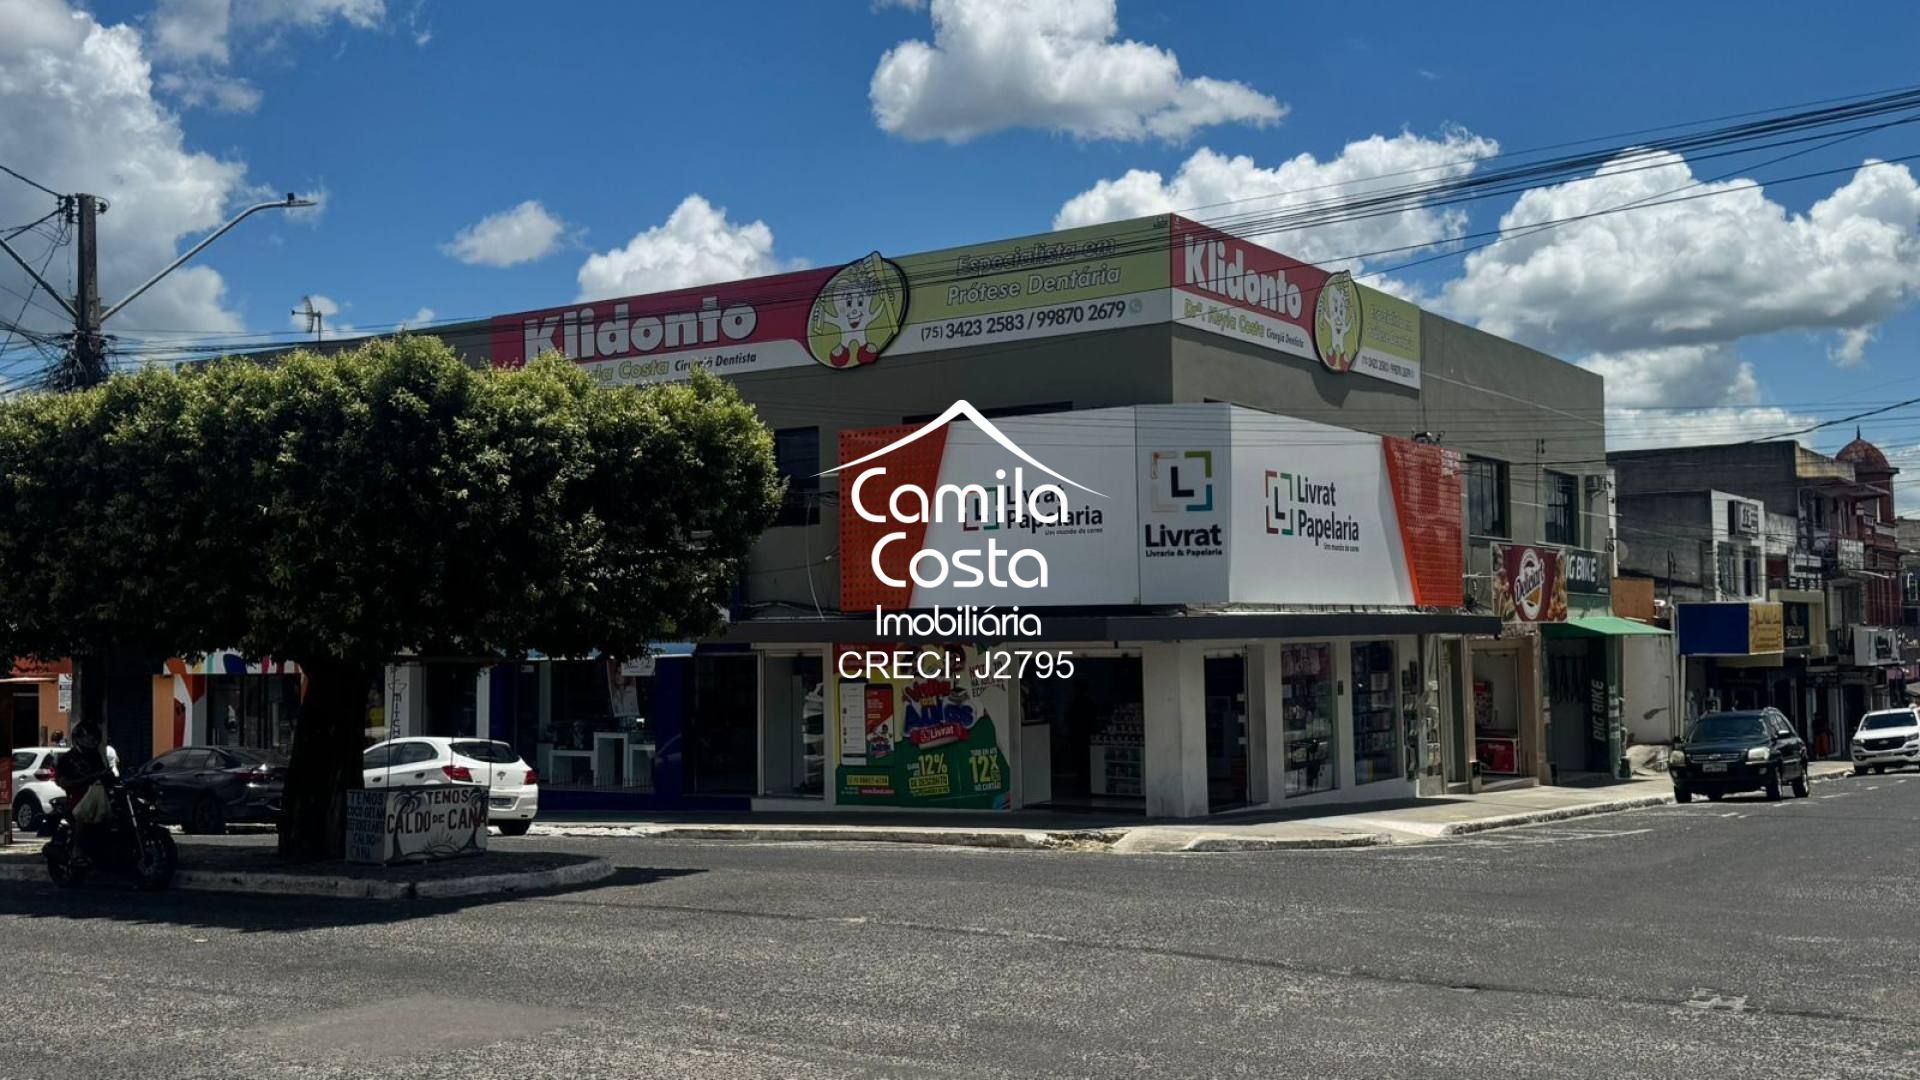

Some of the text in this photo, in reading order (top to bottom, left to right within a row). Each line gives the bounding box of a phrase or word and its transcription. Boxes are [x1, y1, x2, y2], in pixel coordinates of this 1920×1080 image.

[947, 263, 1121, 306] Prótese Dentária
[1184, 233, 1303, 320] Klidonto
[524, 296, 757, 363] Klidonto
[921, 325, 943, 342] (75)
[945, 319, 982, 339] 3423
[986, 313, 1024, 335] 2583
[1037, 306, 1084, 328] 99870
[1088, 300, 1126, 321] 2679
[619, 360, 670, 380] Costa
[716, 352, 757, 367] Dentista
[1298, 474, 1336, 507] Livrat
[1145, 523, 1222, 548] Livrat
[1298, 509, 1359, 546] Papelaria
[1145, 548, 1174, 558] Livraria
[1186, 547, 1222, 559] Papelaria
[1576, 555, 1596, 583] BIKE
[1591, 679, 1606, 713] BIKE
[917, 751, 948, 776] 12%
[425, 789, 469, 805] TEMOS
[387, 811, 431, 834] CALDO
[433, 814, 445, 824] DE
[448, 807, 487, 830] CANA
